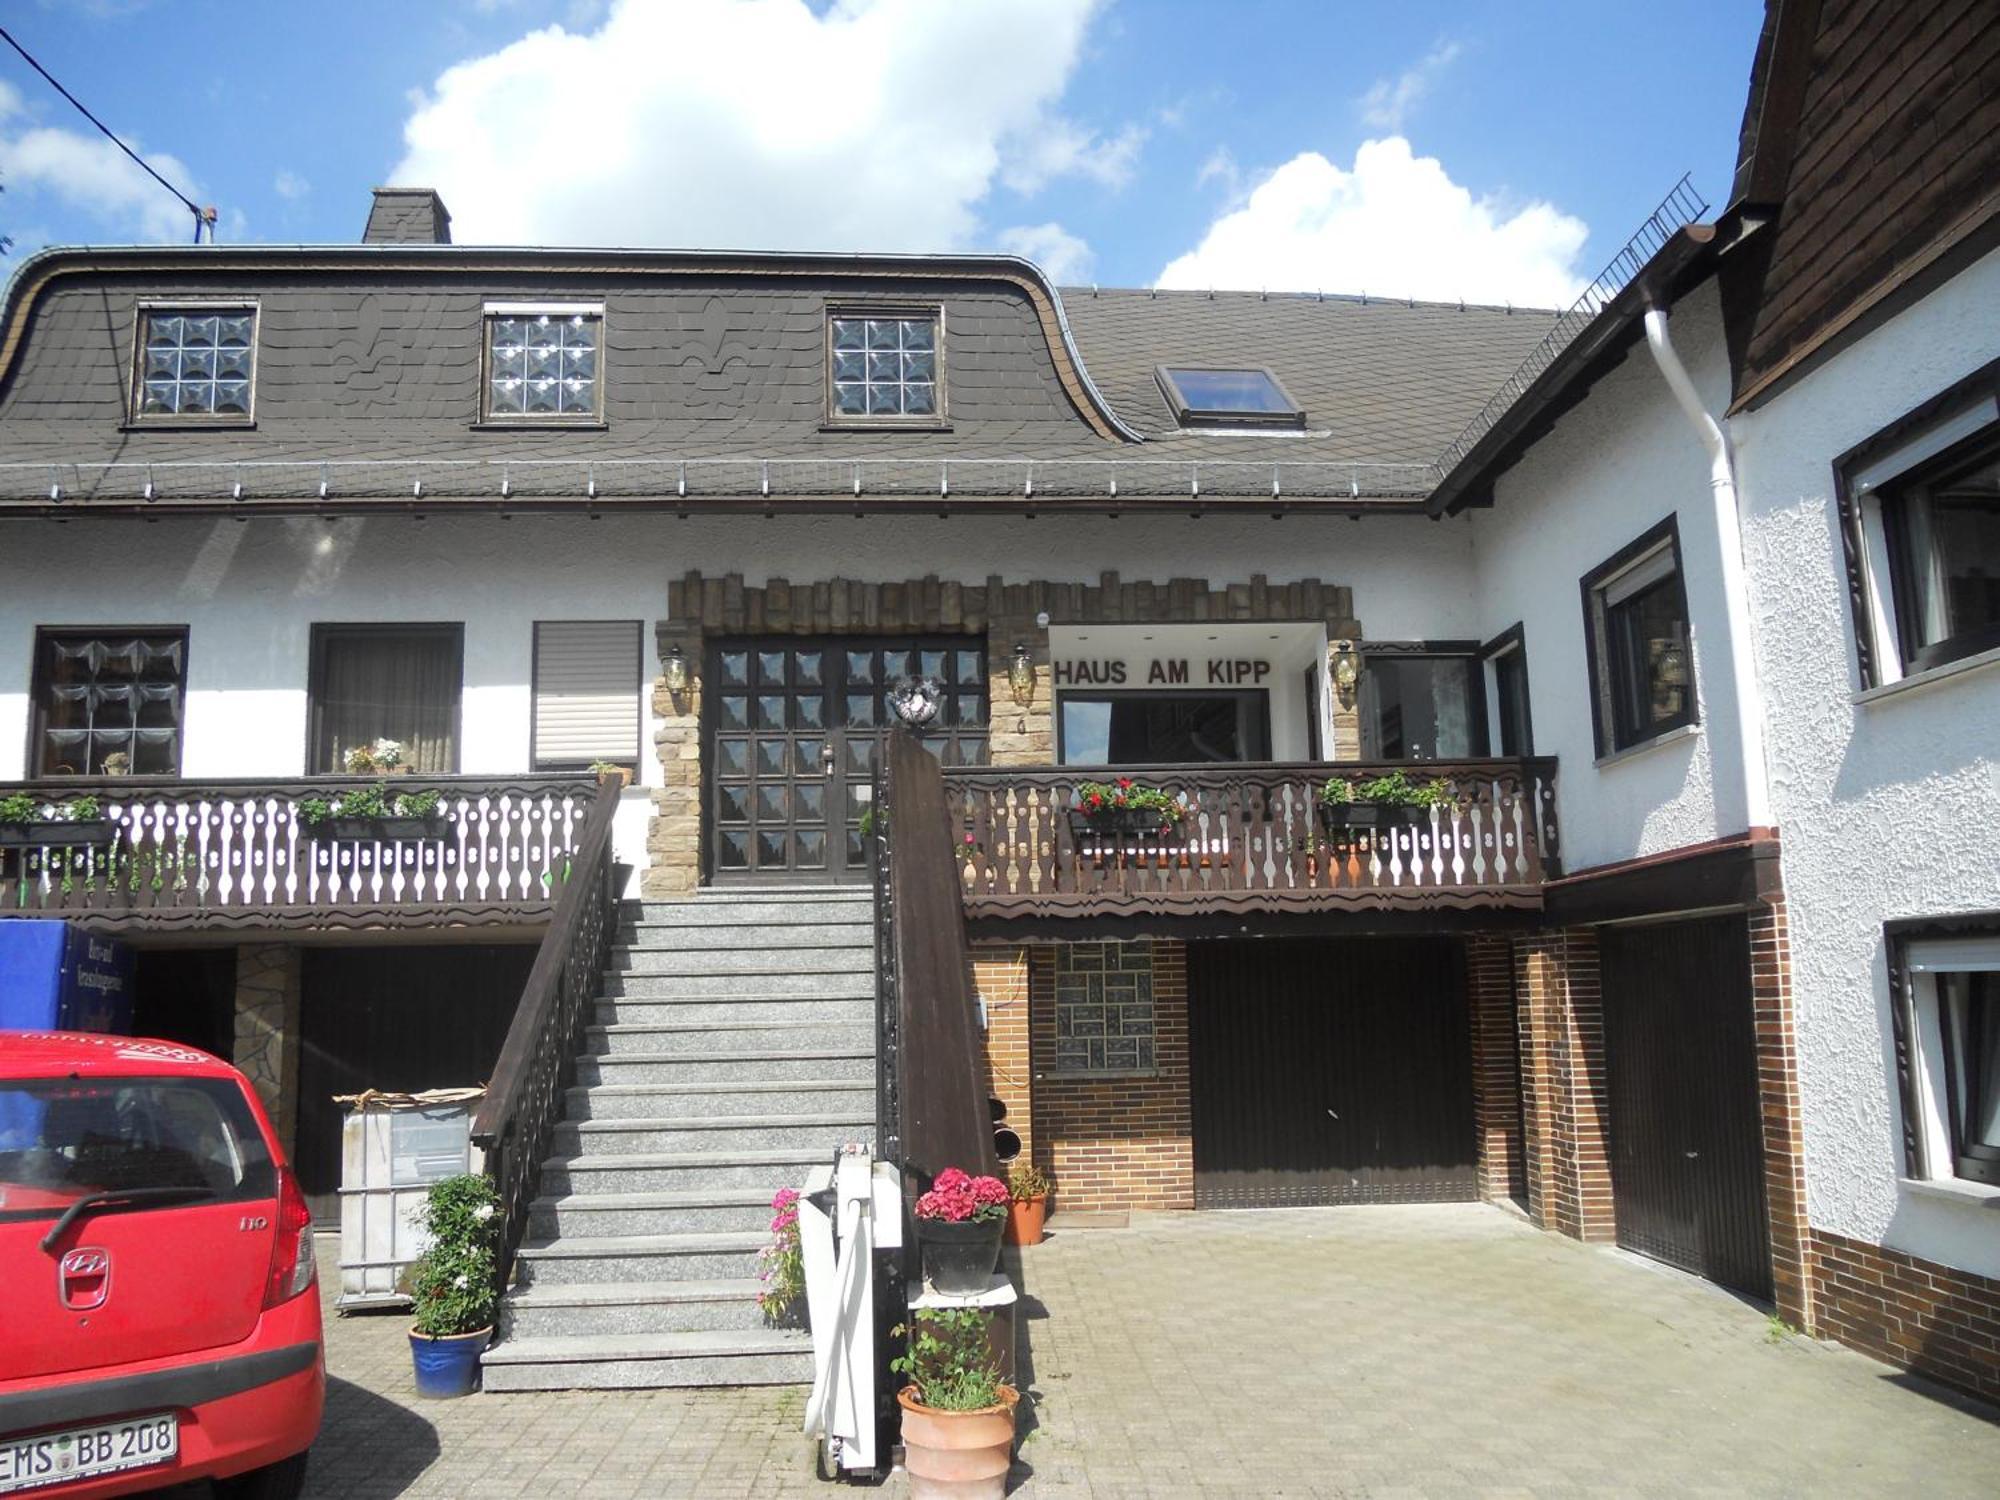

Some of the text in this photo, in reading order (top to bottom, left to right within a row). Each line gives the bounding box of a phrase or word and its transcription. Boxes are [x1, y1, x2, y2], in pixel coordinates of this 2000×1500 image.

[1054, 660, 1271, 684] HAUS AM KIPP
[77, 1430, 113, 1466] BB
[120, 1420, 171, 1458] 208
